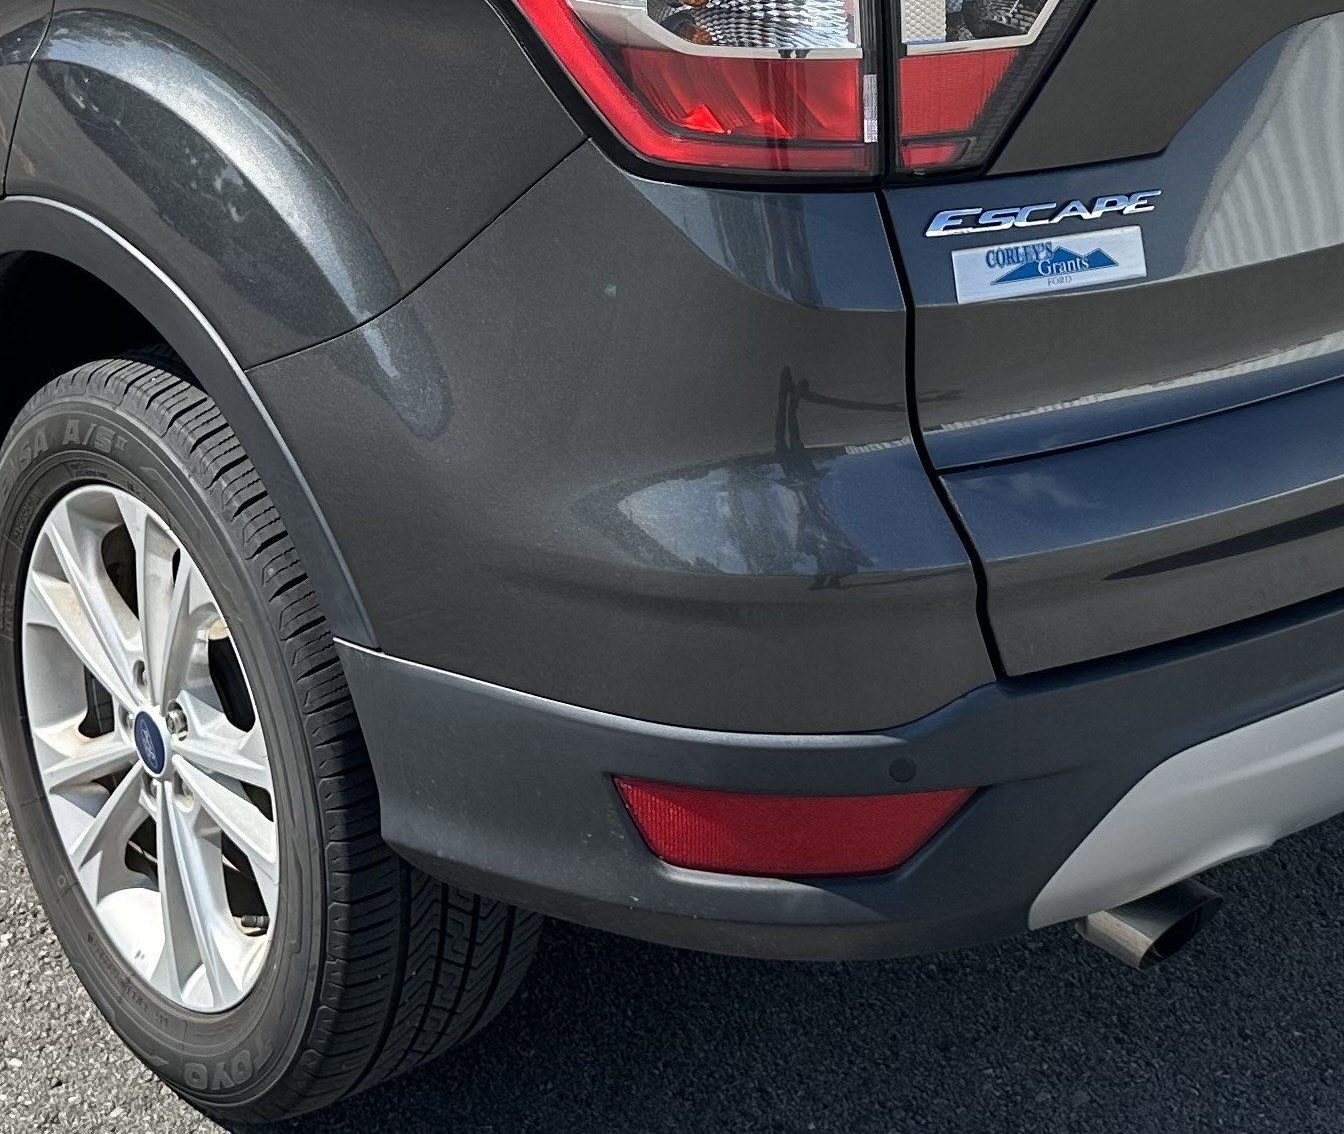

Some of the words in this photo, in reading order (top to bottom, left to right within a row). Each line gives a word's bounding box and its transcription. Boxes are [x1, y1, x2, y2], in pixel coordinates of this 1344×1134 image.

[925, 188, 1163, 238] ESCAPE
[985, 240, 1054, 270] CORLEY'S
[1037, 256, 1090, 277] Grants
